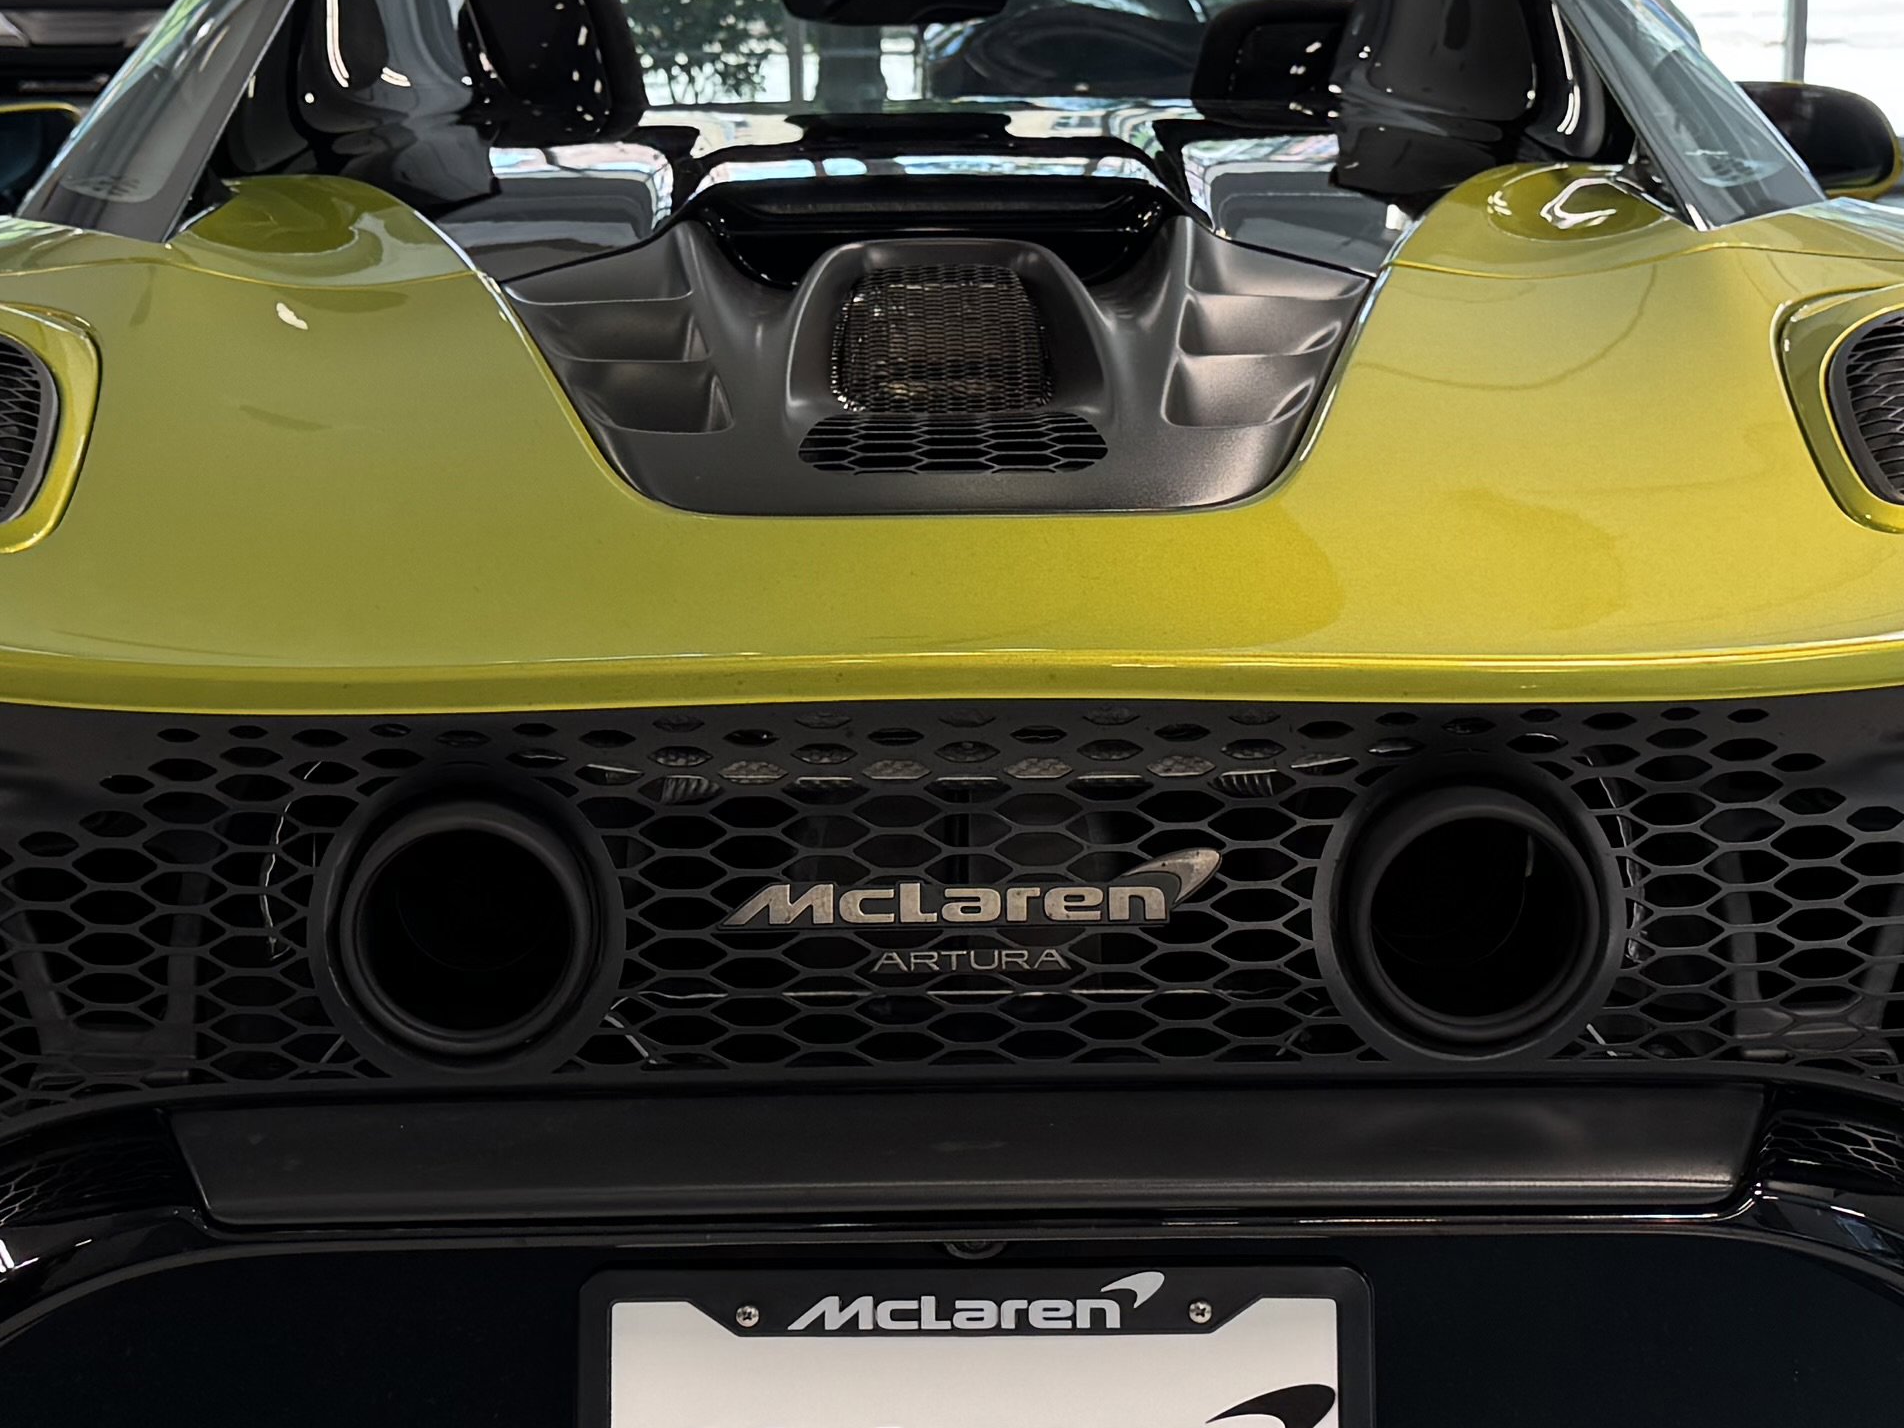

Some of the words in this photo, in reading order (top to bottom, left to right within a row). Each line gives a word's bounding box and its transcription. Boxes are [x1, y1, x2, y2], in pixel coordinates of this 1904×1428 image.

[721, 878, 1172, 926] McLaren
[871, 947, 1073, 973] ARTURA
[786, 1292, 1123, 1331] McLaren
